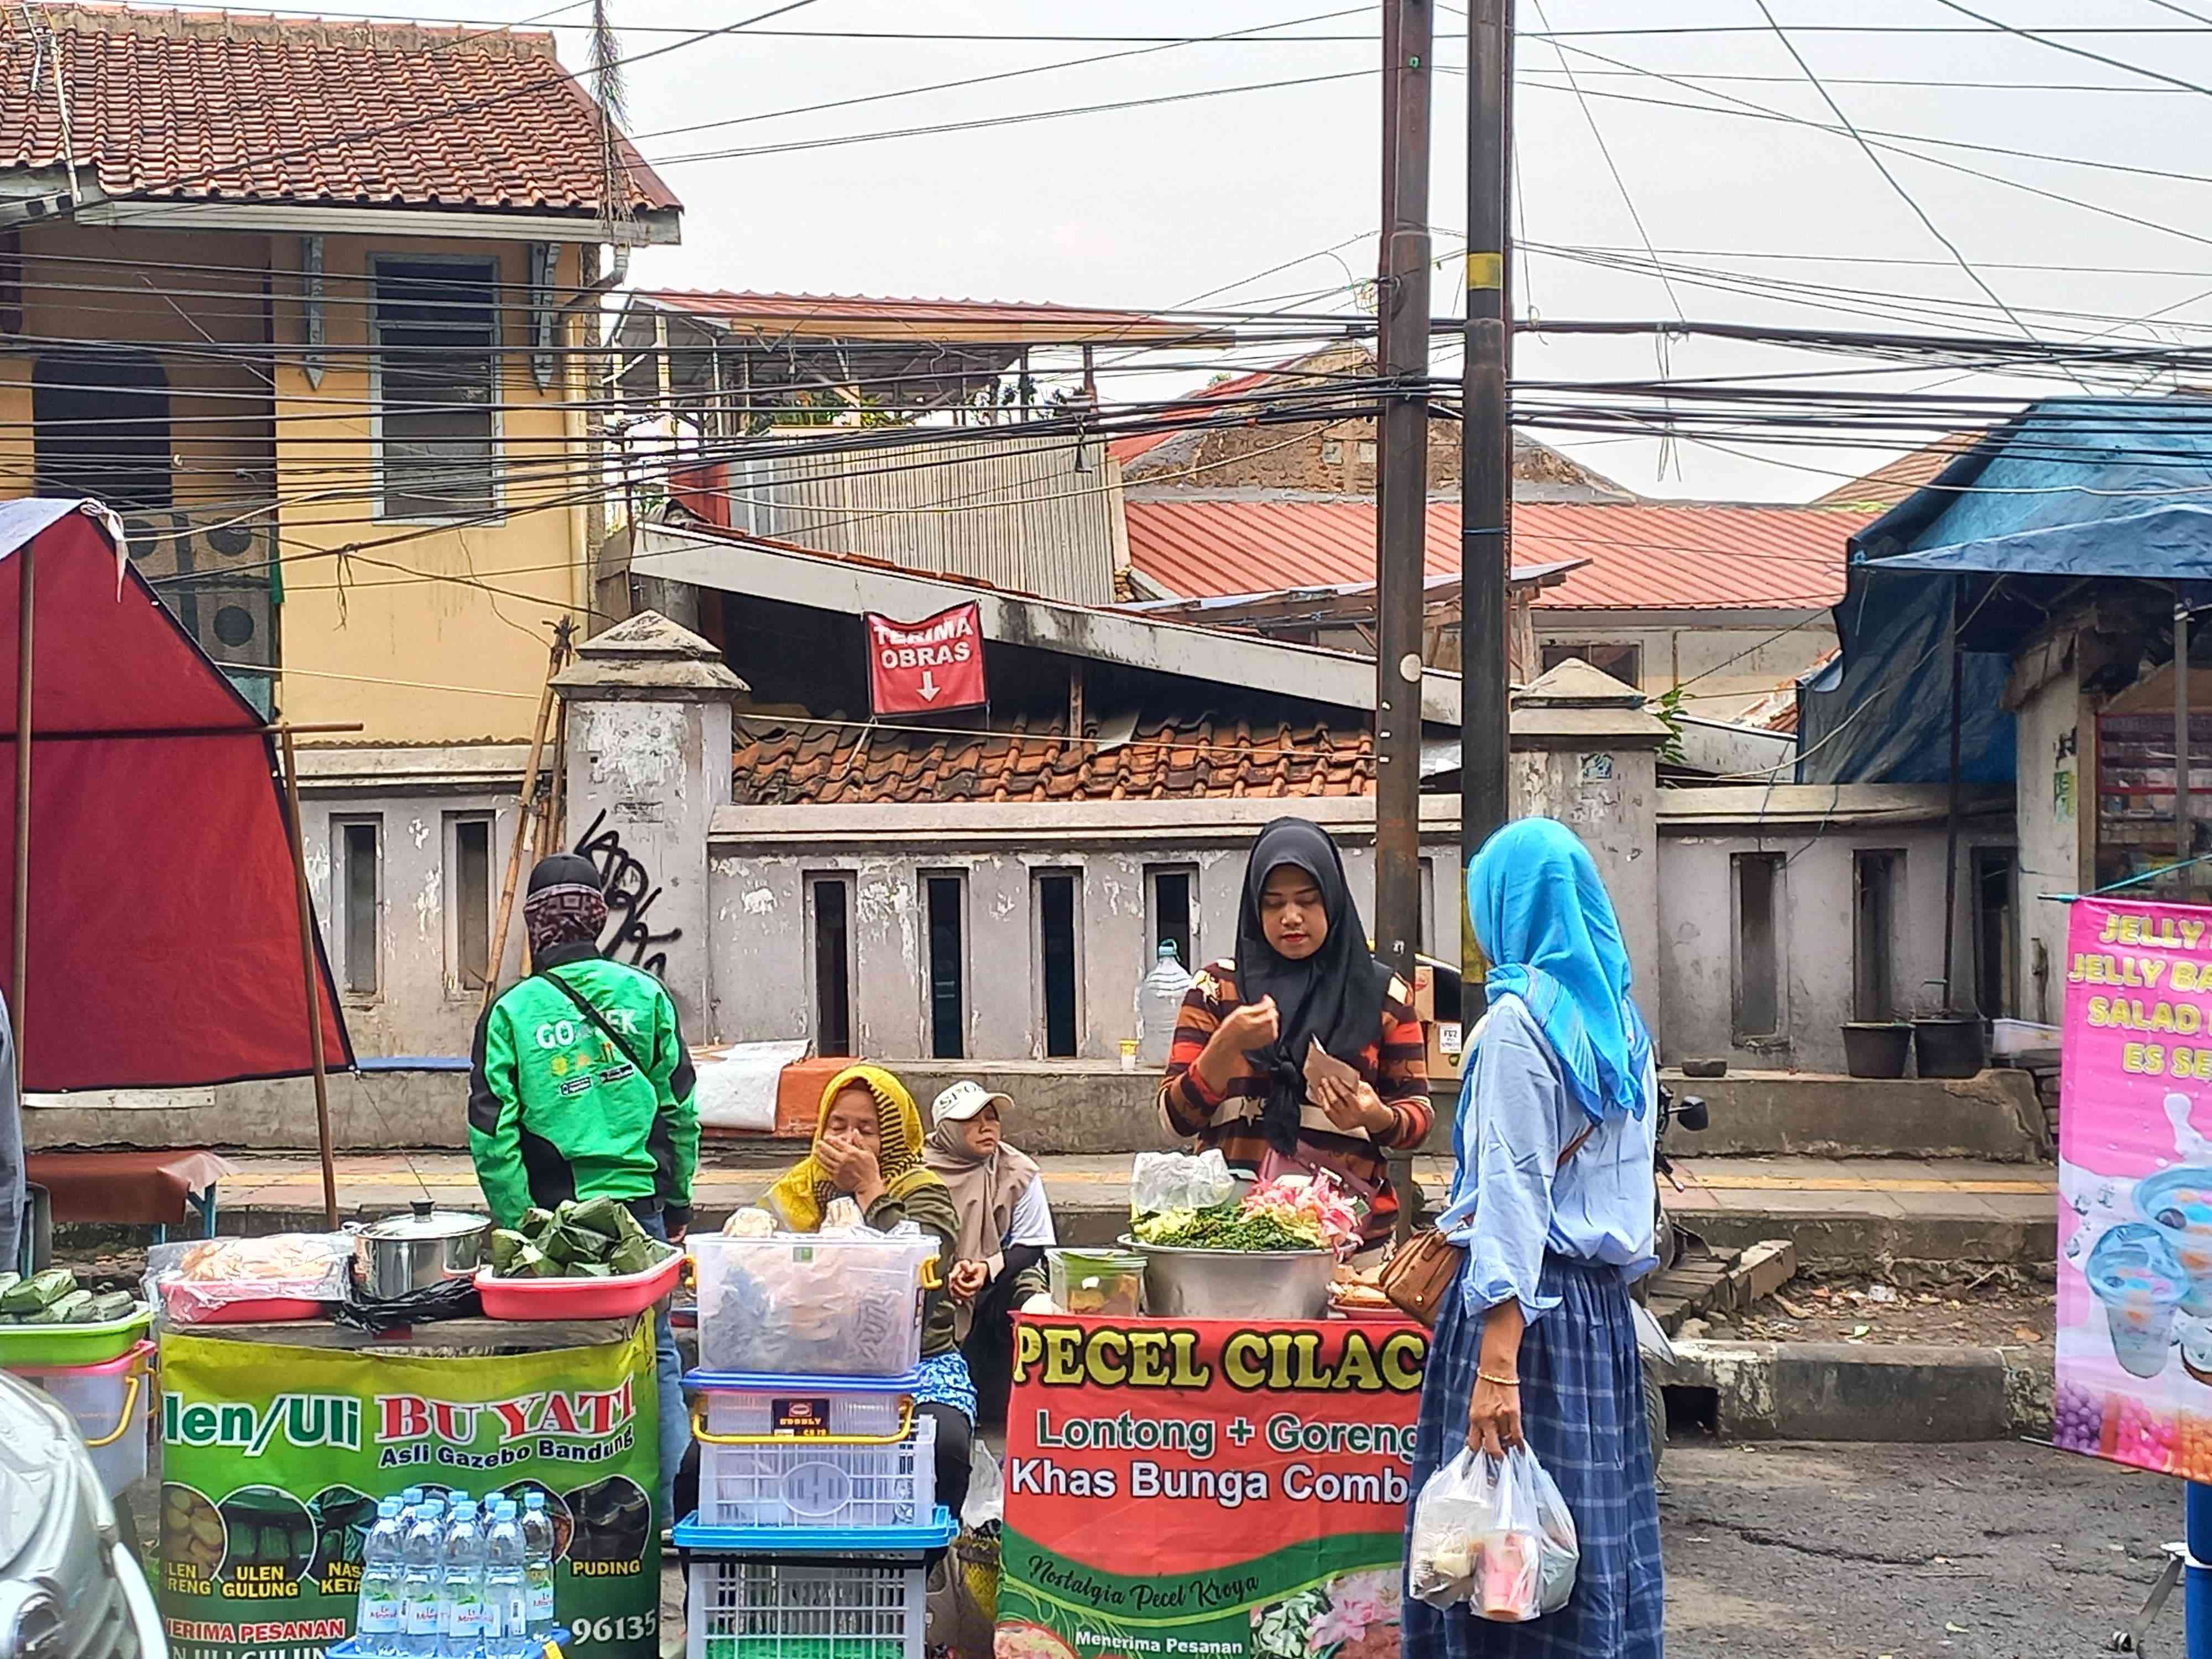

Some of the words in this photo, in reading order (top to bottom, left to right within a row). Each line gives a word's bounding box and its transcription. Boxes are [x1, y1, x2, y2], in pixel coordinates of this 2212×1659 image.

[880, 641, 971, 669] OBRAS
[2099, 914, 2205, 950] JELLY
[2068, 953, 2166, 988] JELLY
[2088, 996, 2201, 1035] SALAD
[2123, 1042, 2165, 1075] ES
[1013, 1325, 1211, 1387] PECEL
[1223, 1332, 1425, 1390] CILAC
[374, 1392, 480, 1445] BU
[487, 1373, 637, 1445] YATI
[378, 1442, 430, 1468] Asli
[437, 1444, 533, 1469] Gazebo
[538, 1425, 634, 1463] Bandung
[1037, 1408, 1215, 1459] Lontong
[1226, 1416, 1255, 1447] +
[1011, 1459, 1117, 1497] Khas
[1130, 1460, 1270, 1508] Bunga
[237, 1566, 284, 1581] ULEN
[328, 1562, 366, 1578] NAS
[573, 1559, 640, 1575] PUDING
[1028, 1554, 1126, 1605] Nostalgia
[1129, 1584, 1186, 1611] Pecel
[222, 1582, 298, 1598] GULUNG
[239, 1619, 346, 1644] PESANAN
[572, 1609, 655, 1645] 96135
[1076, 1631, 1160, 1652] Menerima
[1166, 1638, 1243, 1654] Pesanan
